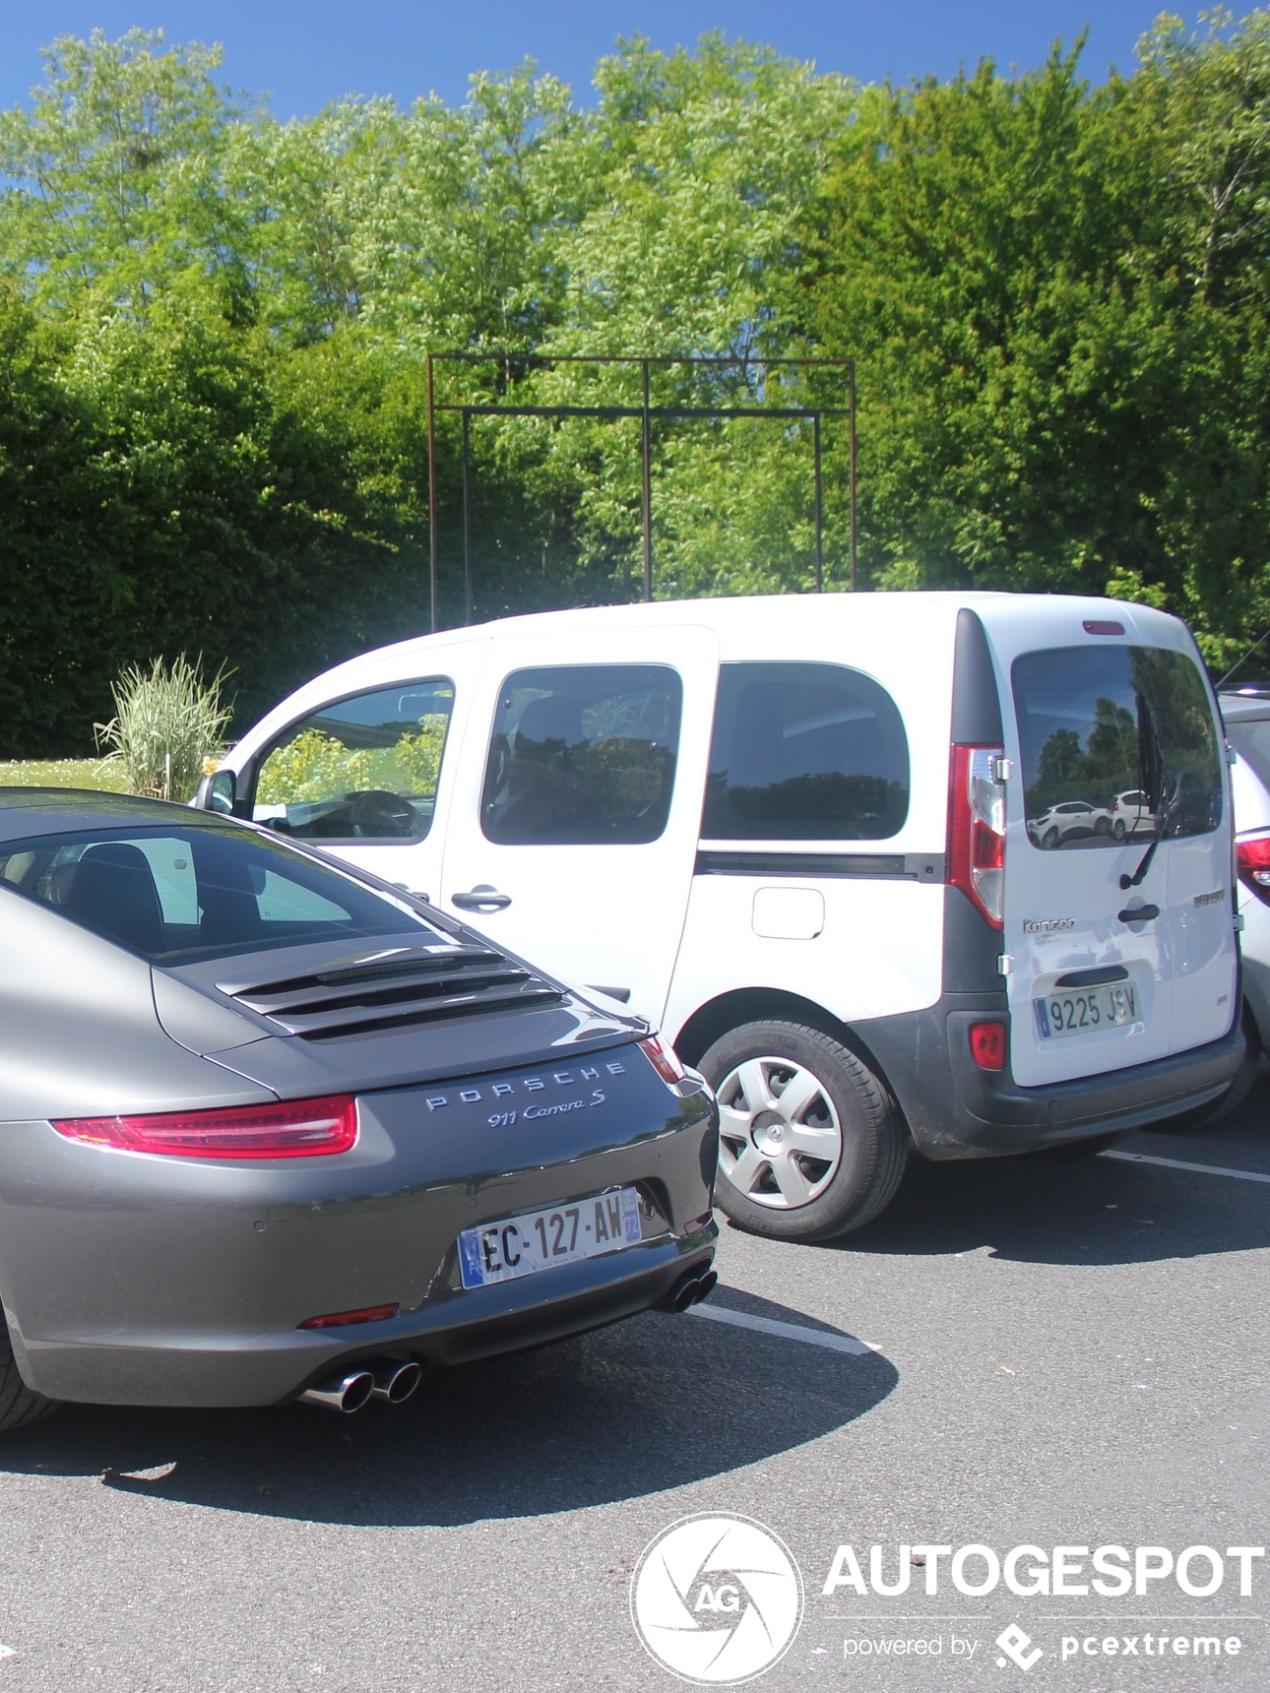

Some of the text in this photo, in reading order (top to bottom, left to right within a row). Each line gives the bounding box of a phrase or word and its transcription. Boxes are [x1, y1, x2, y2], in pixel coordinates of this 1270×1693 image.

[1050, 995, 1100, 1031] 9225
[426, 1062, 626, 1112] PORSCHE
[487, 1088, 607, 1129] 911 Carrera S
[624, 1215, 639, 1235] 72
